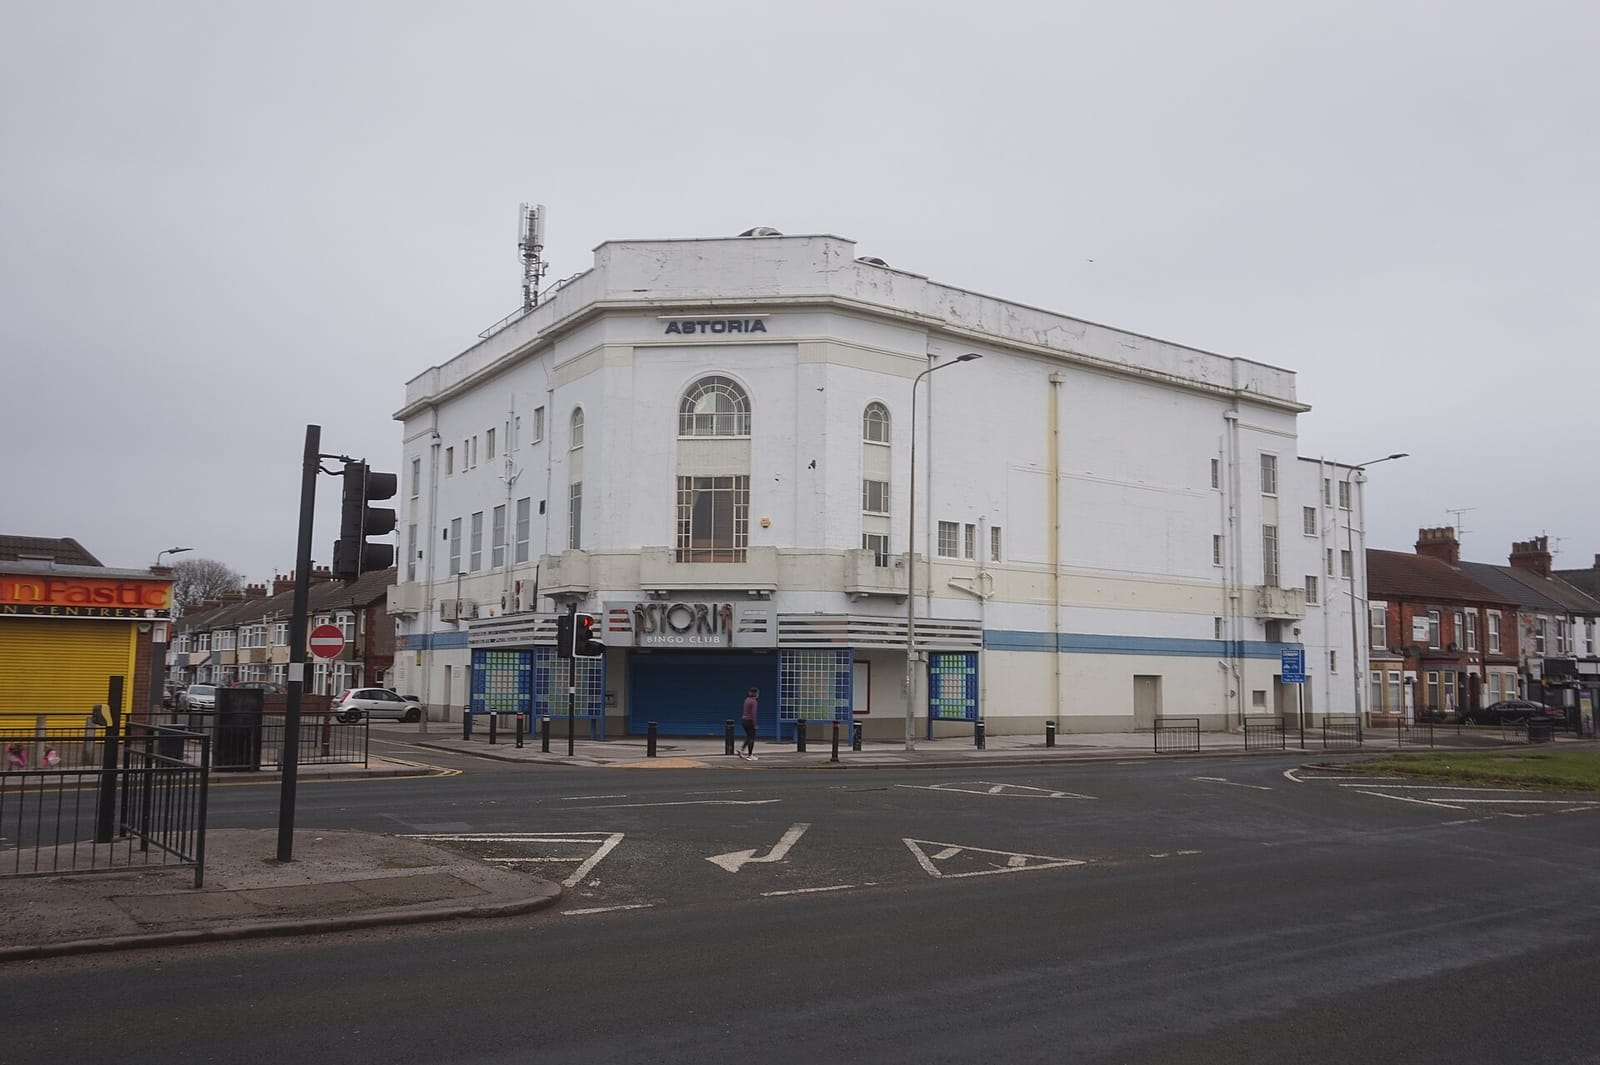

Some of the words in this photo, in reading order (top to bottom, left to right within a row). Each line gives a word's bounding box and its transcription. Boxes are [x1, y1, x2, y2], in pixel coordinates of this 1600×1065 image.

[664, 319, 767, 334] ASTORIA
[32, 605, 140, 617] CENTRES
[646, 635, 684, 644] BINGO
[689, 635, 721, 644] CLUB
